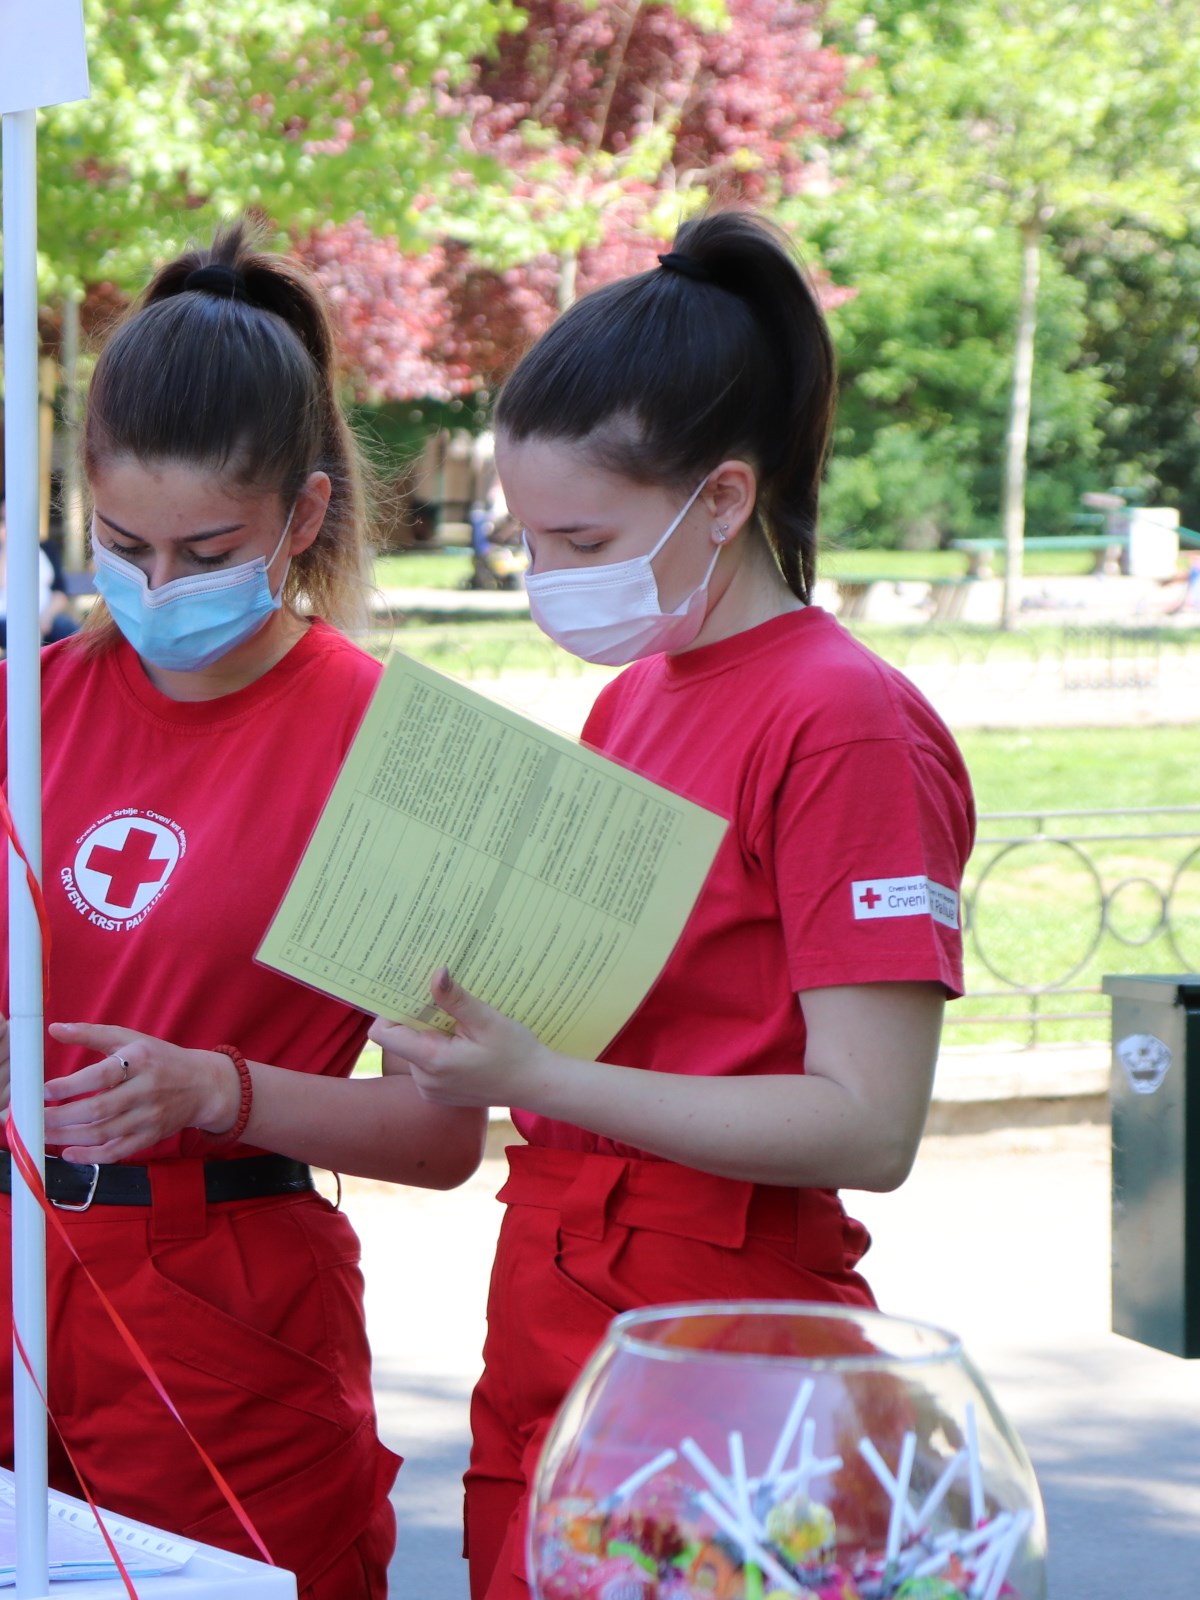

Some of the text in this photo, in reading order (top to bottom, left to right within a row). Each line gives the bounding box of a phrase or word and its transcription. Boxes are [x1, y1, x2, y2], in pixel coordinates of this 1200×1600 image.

[97, 814, 113, 825] krst
[113, 807, 138, 817] Srbije
[146, 810, 172, 825] Crveni
[60, 867, 90, 915] CRVENI
[88, 911, 123, 932] KRST
[888, 893, 926, 908] Crveni
